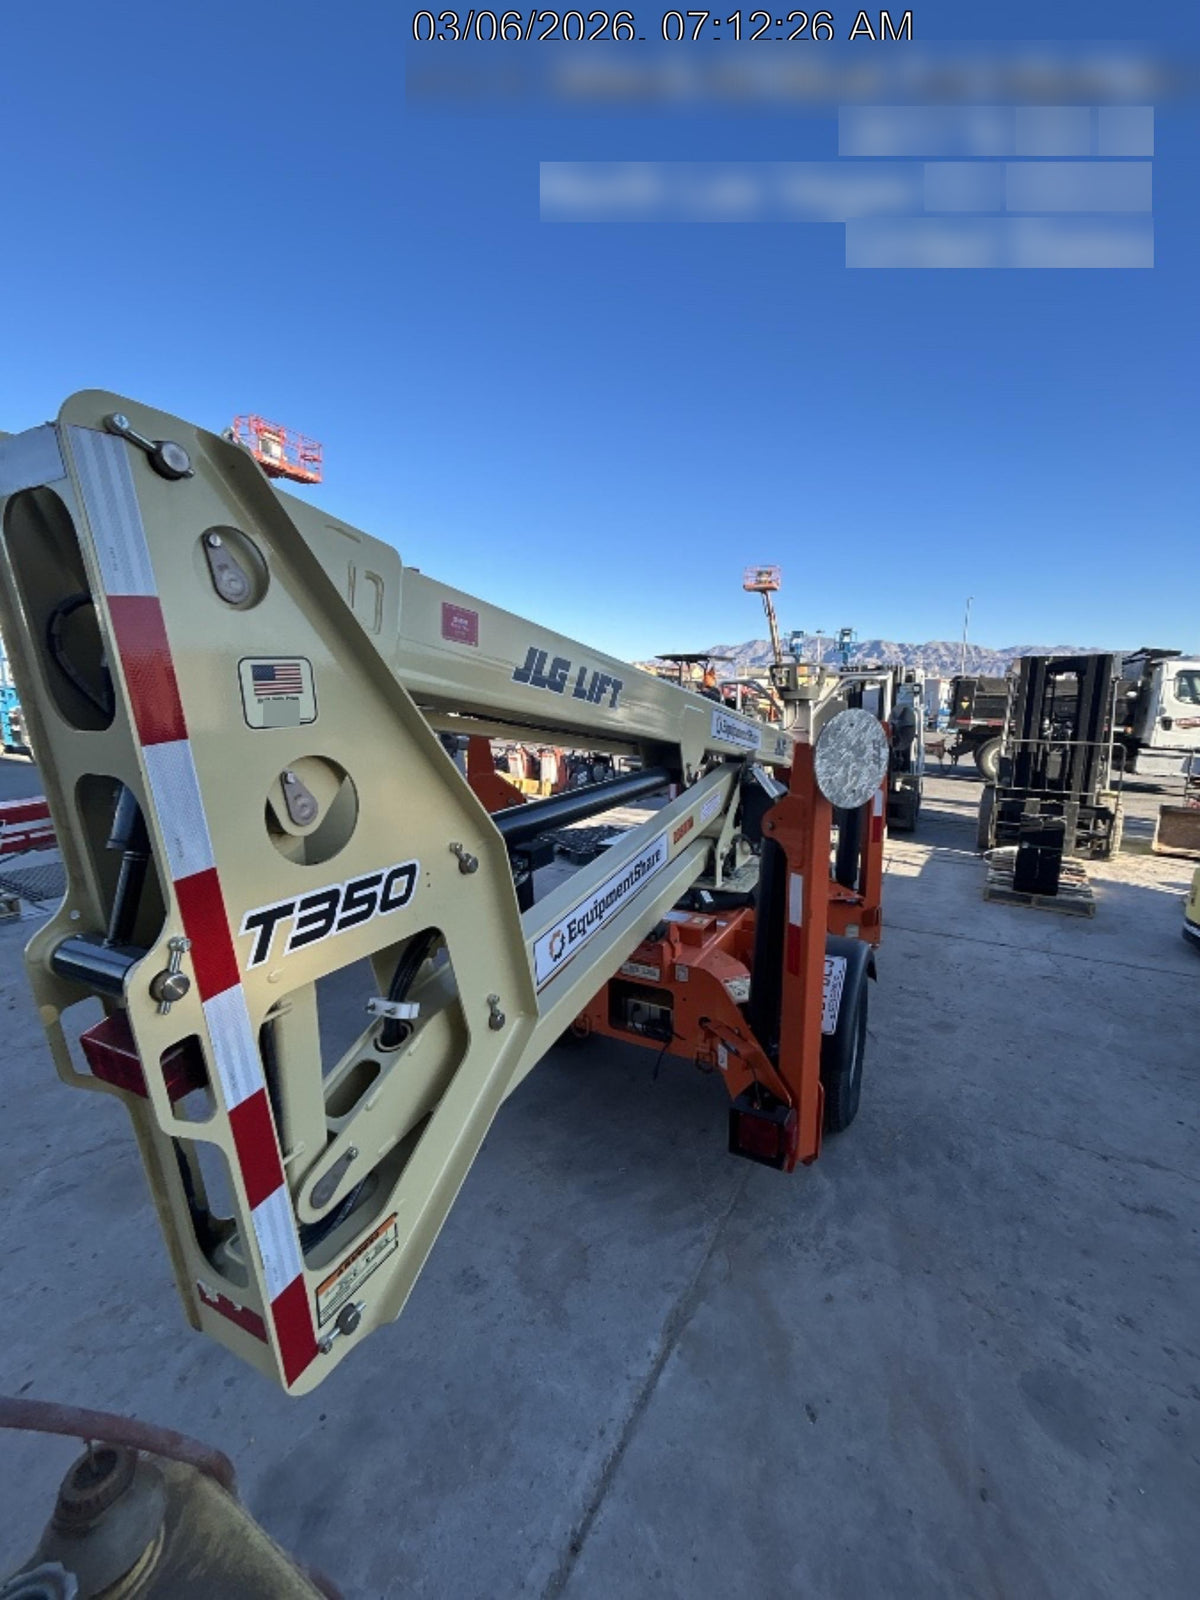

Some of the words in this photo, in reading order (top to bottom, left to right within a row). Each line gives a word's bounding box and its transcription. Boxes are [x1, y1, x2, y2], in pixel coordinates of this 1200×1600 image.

[511, 646, 571, 695] JLG
[571, 665, 624, 709] LIFT
[242, 861, 419, 967] T350
[566, 848, 662, 944] EquipmentShare
